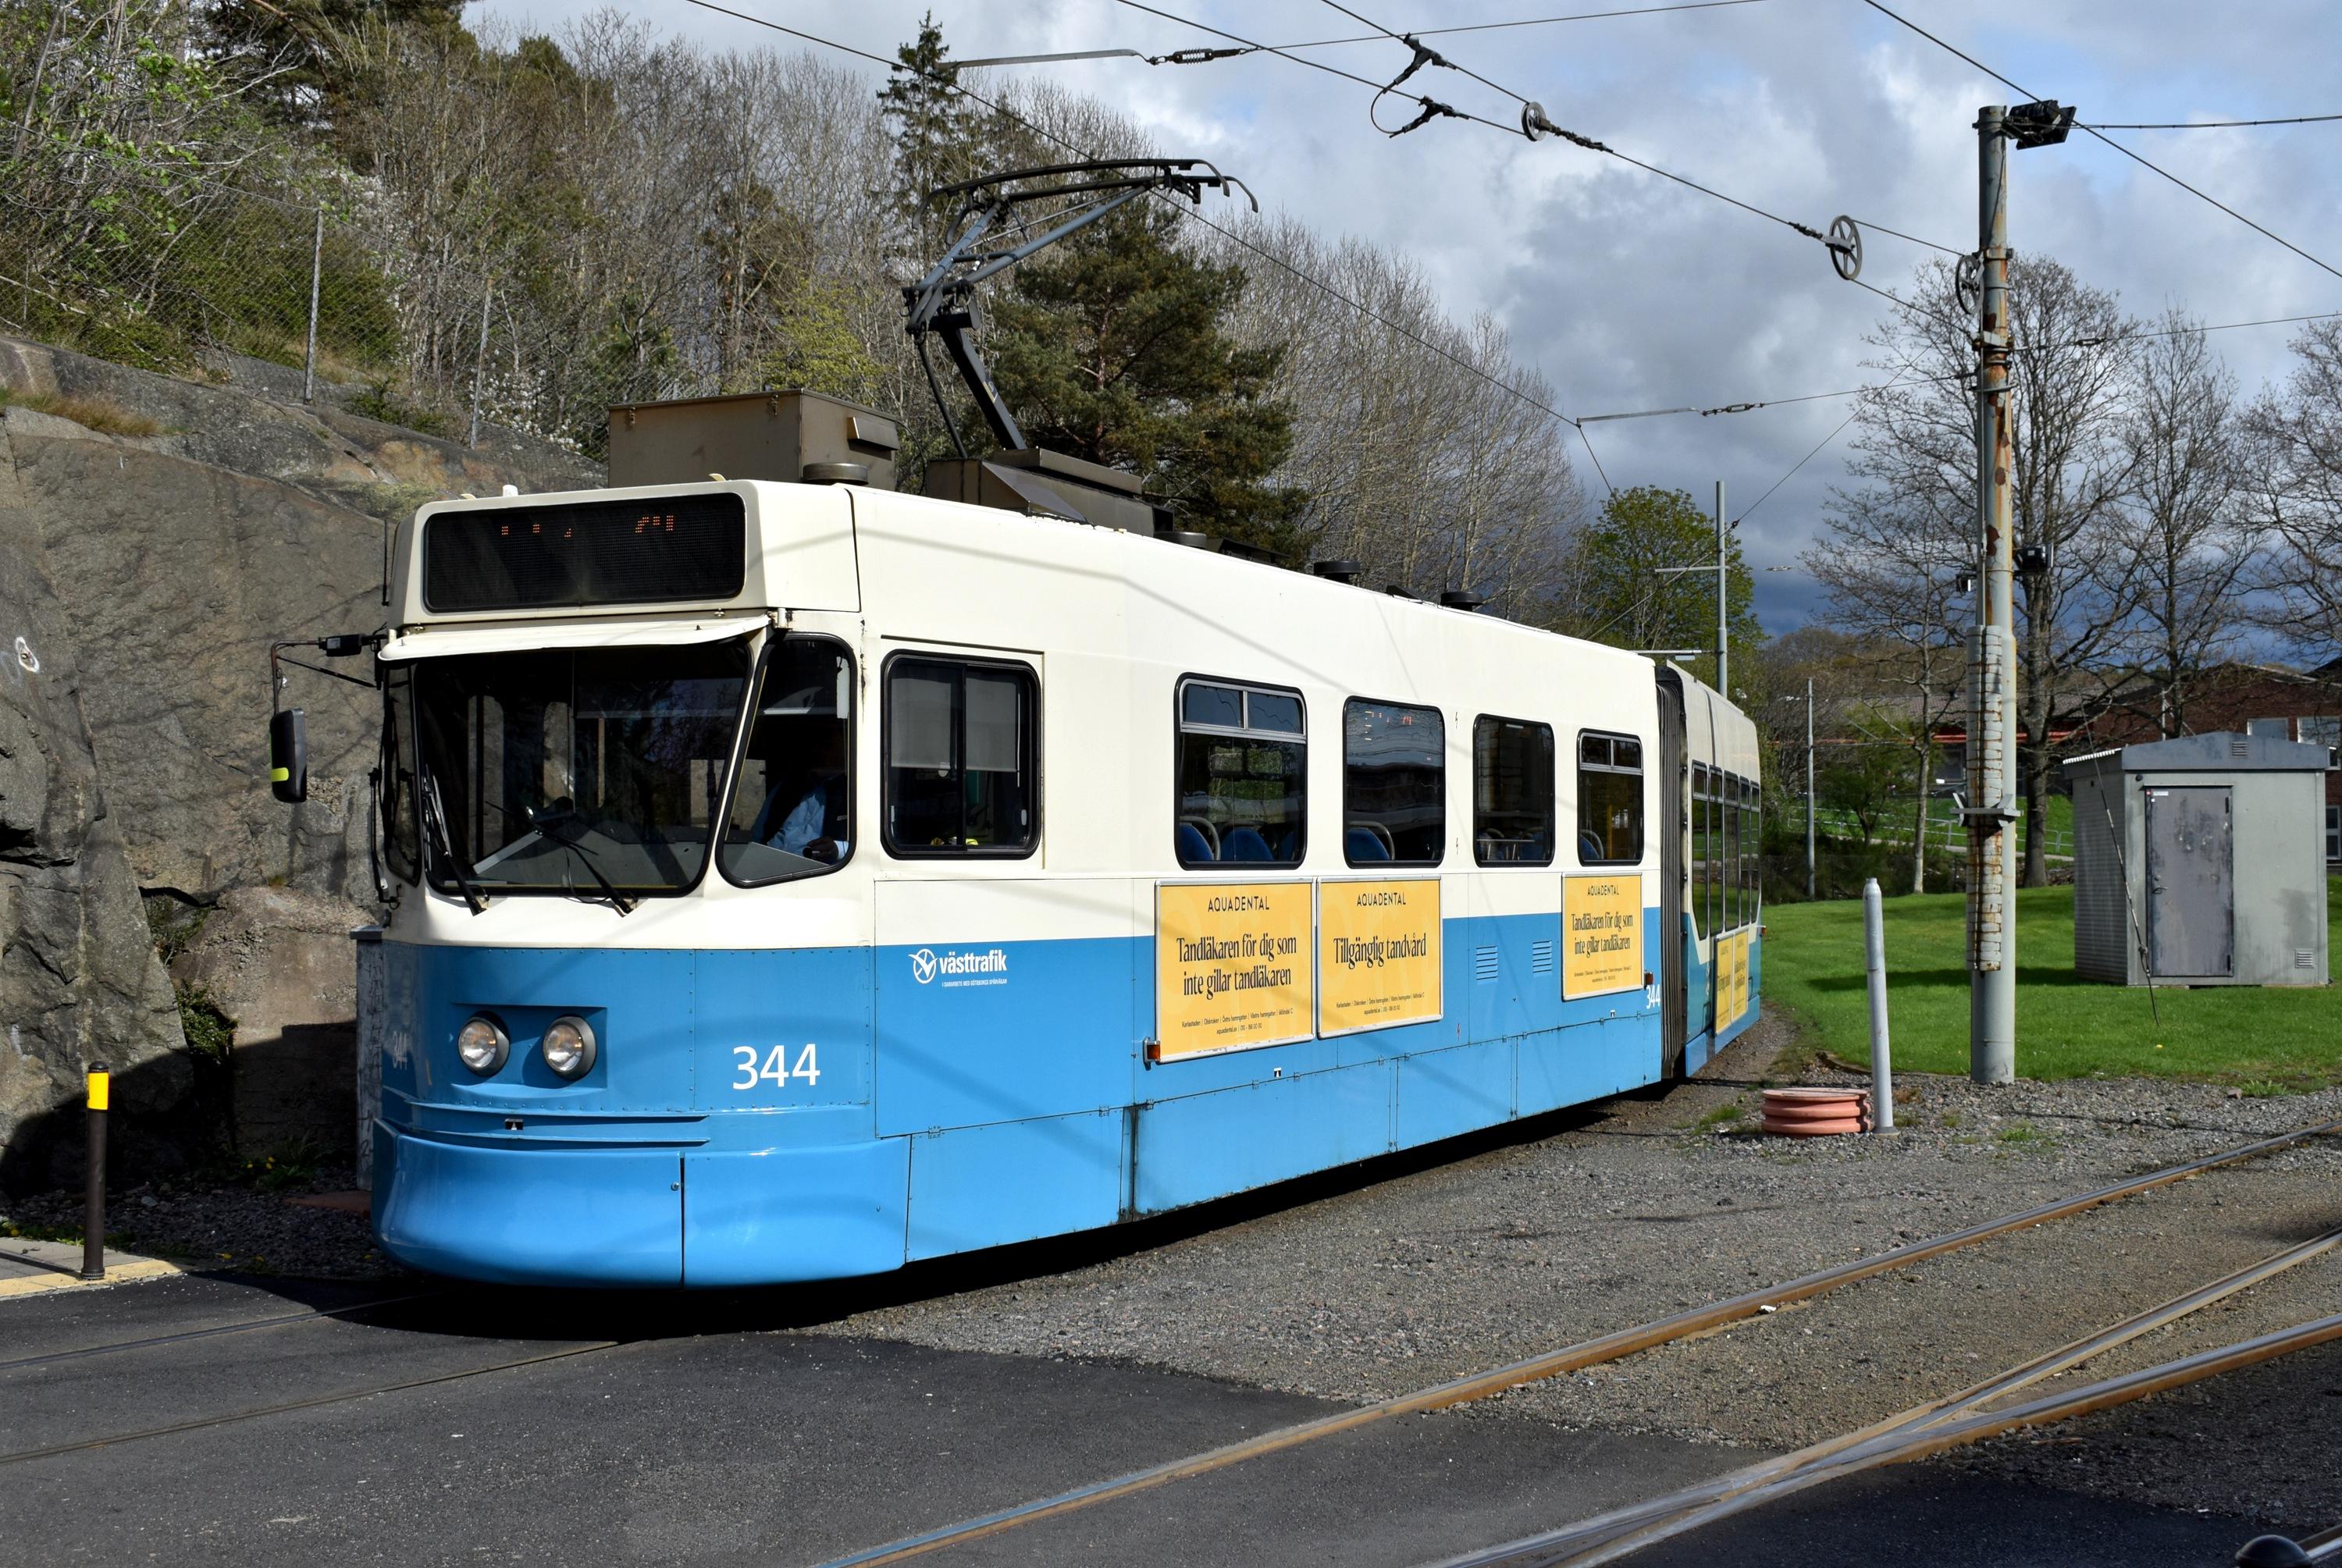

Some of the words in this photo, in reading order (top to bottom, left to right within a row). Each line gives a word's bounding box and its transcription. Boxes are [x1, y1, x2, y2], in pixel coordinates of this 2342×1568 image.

[1208, 895, 1270, 912] AQUADENTAL
[1357, 892, 1407, 906] AQUADENTAL
[1587, 884, 1620, 897] AQUADENTAL
[1571, 912, 1604, 931] Tandläkaren
[1604, 912, 1613, 928] för
[1614, 911, 1622, 931] dig
[1623, 914, 1634, 928] som
[1176, 936, 1240, 962] Tandläkaren
[1242, 933, 1257, 958] för
[1259, 932, 1275, 962] dig
[1277, 937, 1297, 955] som
[1333, 935, 1384, 970] Tillgänglig
[1386, 932, 1426, 960] tandvård
[1574, 937, 1586, 955] inte
[1586, 936, 1600, 958] gillar
[1600, 934, 1631, 953] tandläkaren
[938, 949, 1008, 975] västtrafik
[1183, 971, 1204, 996] inte
[1206, 968, 1232, 1001] gillar
[1234, 965, 1291, 990] tandläkaren
[1646, 983, 1661, 1009] 344
[393, 1029, 408, 1071] 344
[731, 1043, 820, 1090] 344
